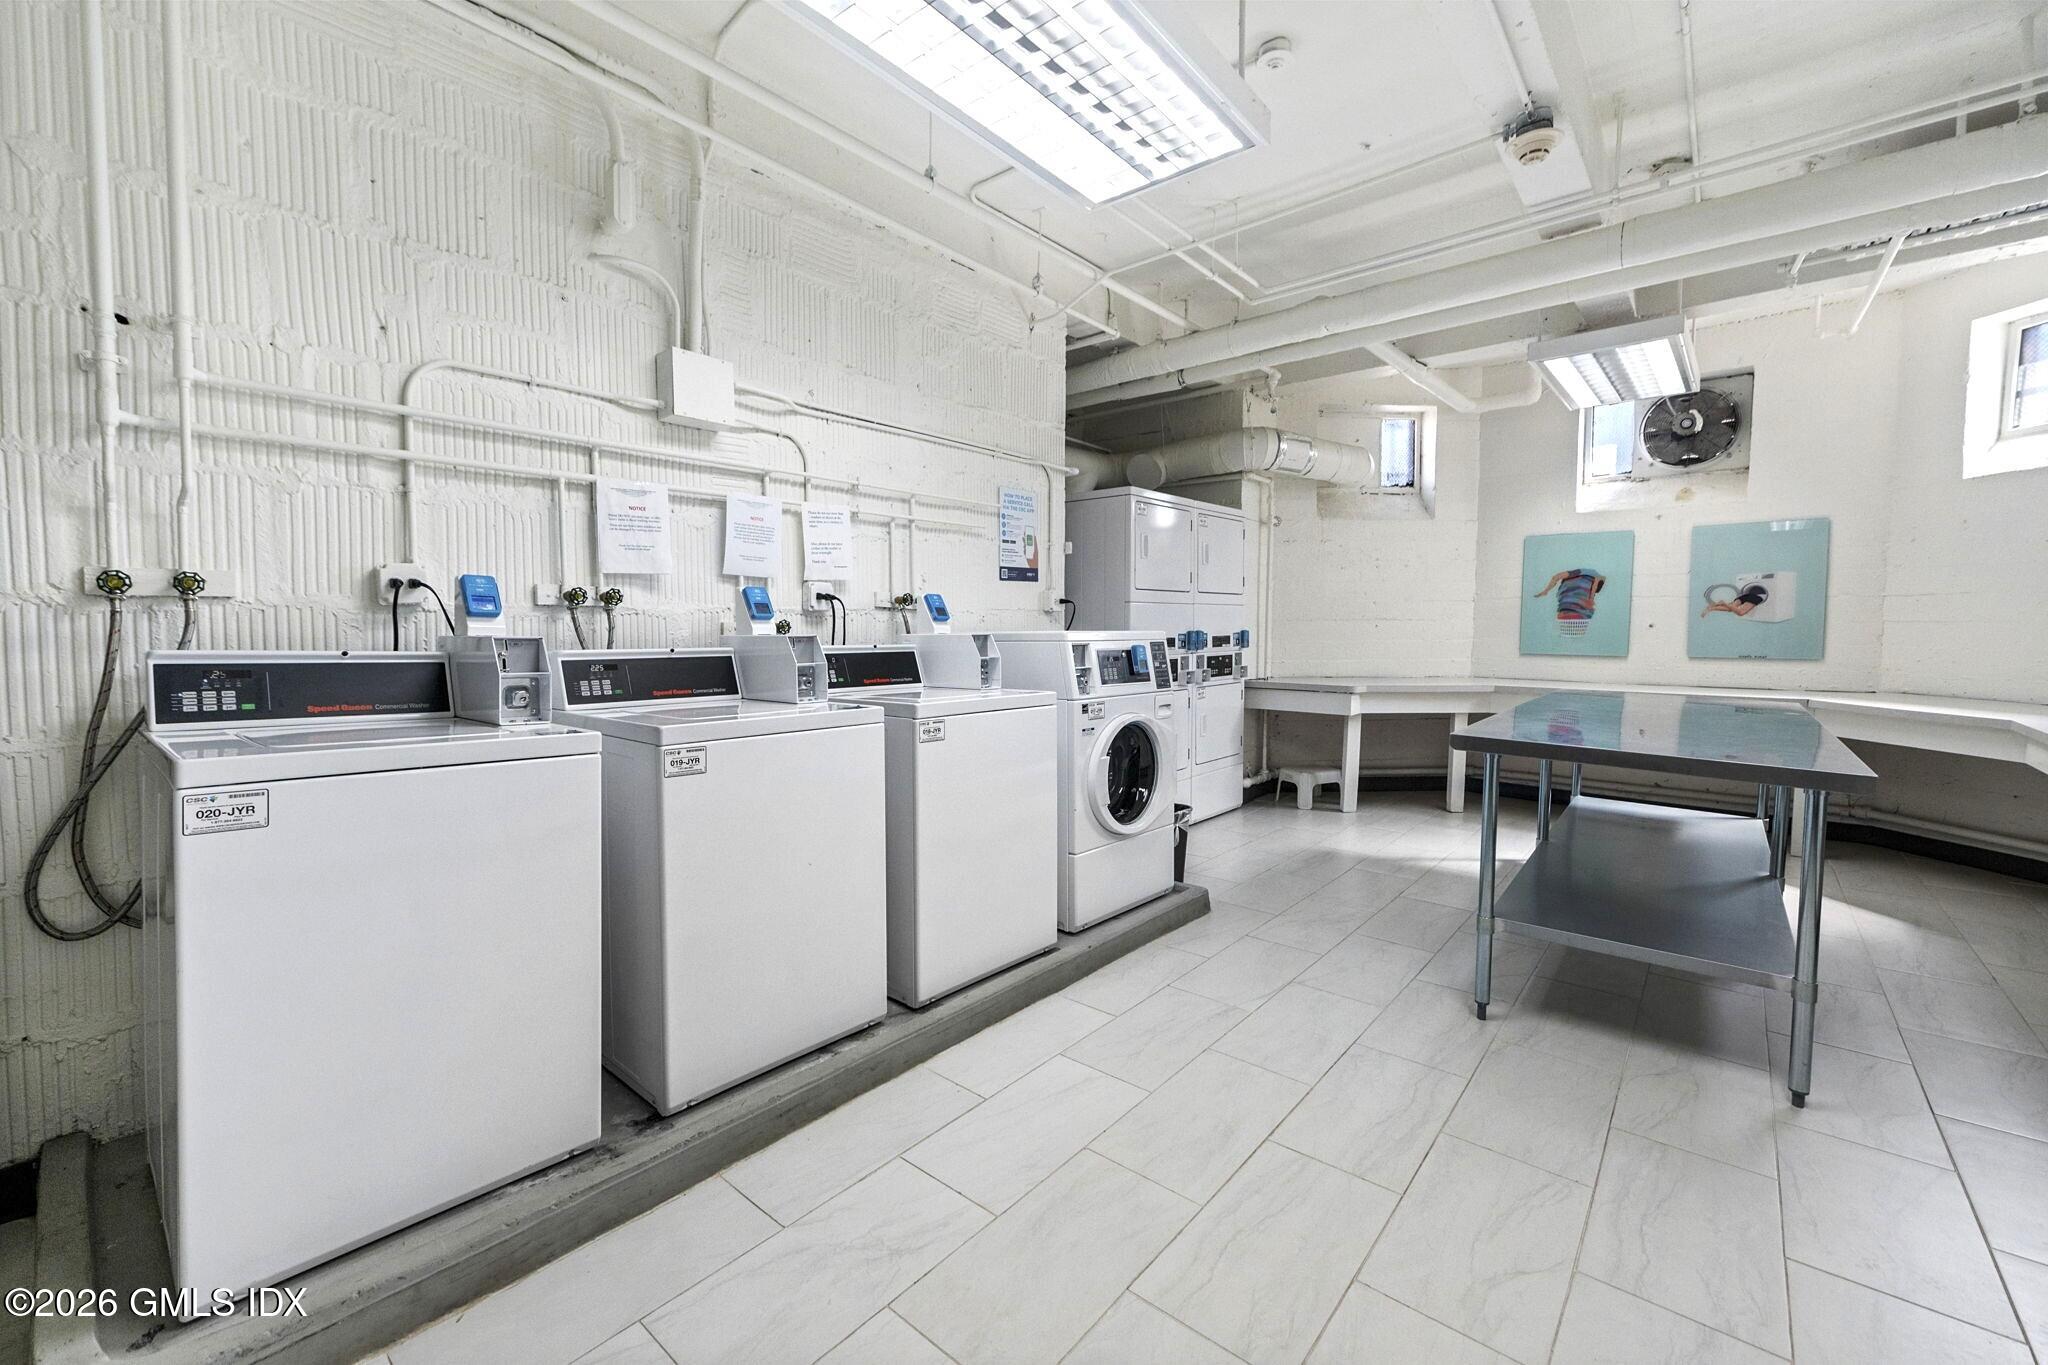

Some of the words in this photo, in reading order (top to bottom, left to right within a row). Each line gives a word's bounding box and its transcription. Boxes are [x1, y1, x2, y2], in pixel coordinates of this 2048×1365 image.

[307, 704, 340, 713] Speed
[341, 703, 373, 712] Queen
[670, 758, 700, 767] 019-JYR
[195, 805, 256, 820] 020-JYR
